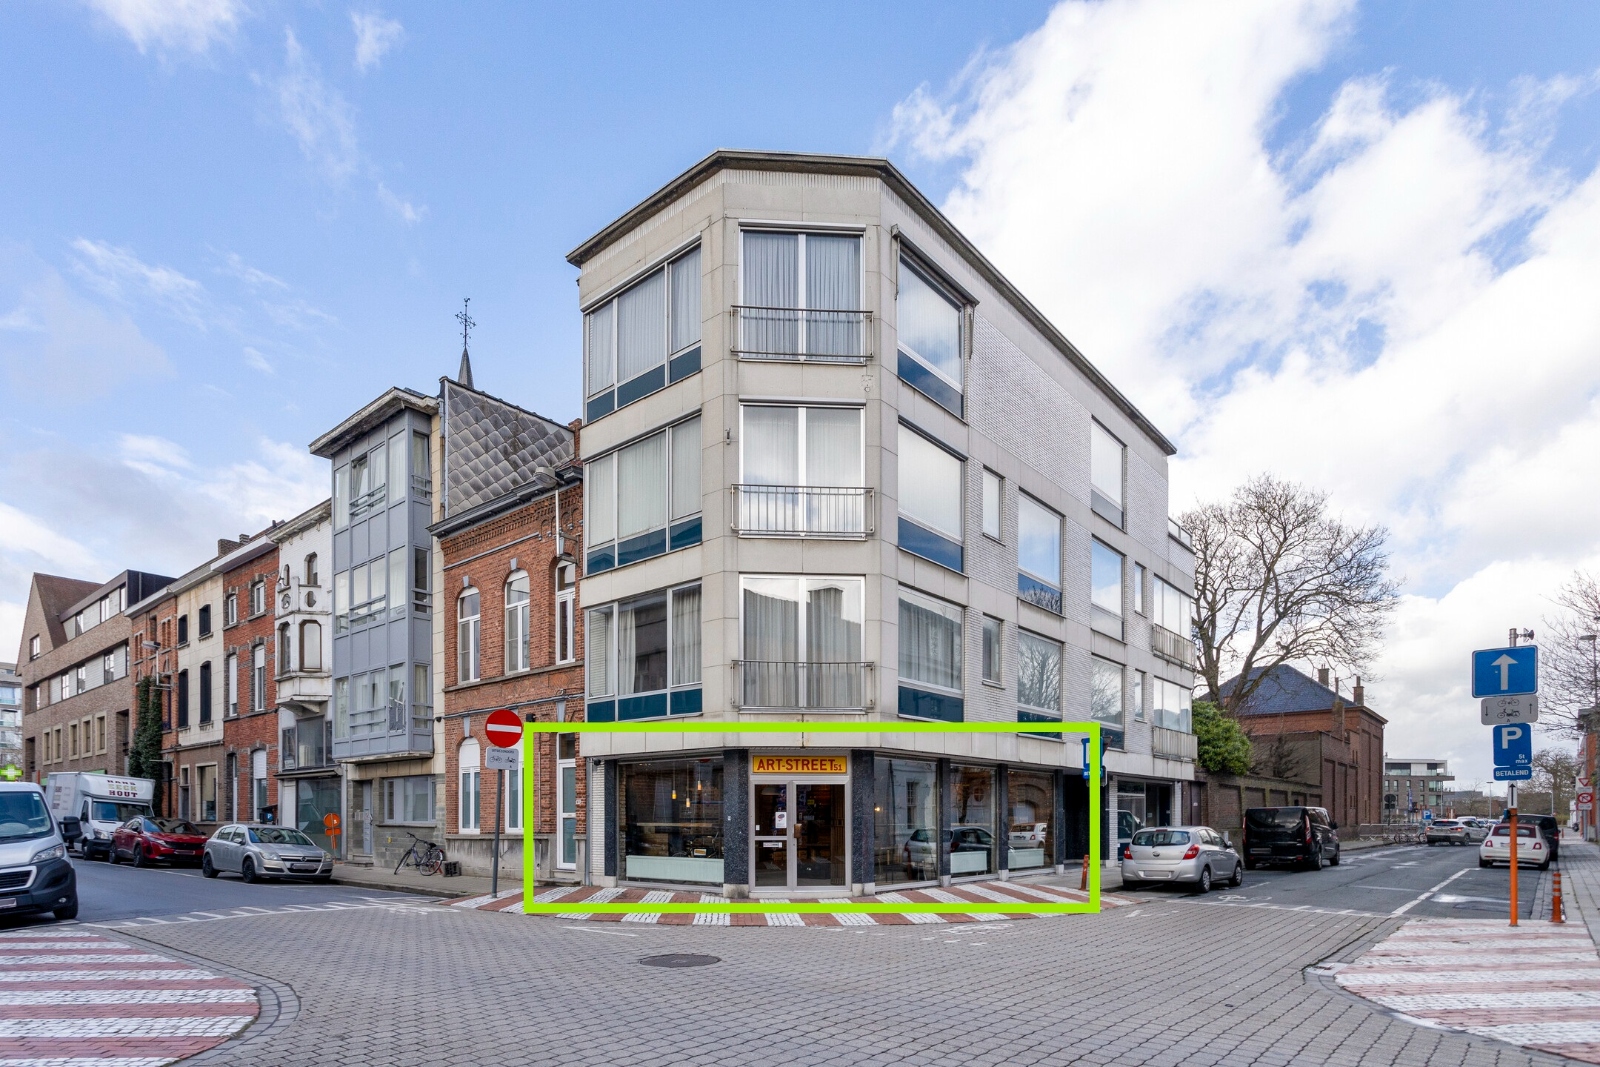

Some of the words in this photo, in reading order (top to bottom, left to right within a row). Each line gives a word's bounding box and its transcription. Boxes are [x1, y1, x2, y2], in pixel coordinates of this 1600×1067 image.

[1501, 727, 1523, 749] P
[757, 758, 835, 771] ART-STREET
[1495, 769, 1529, 777] BETALEND
[109, 789, 138, 798] HOUT
[1423, 810, 1430, 819] P
